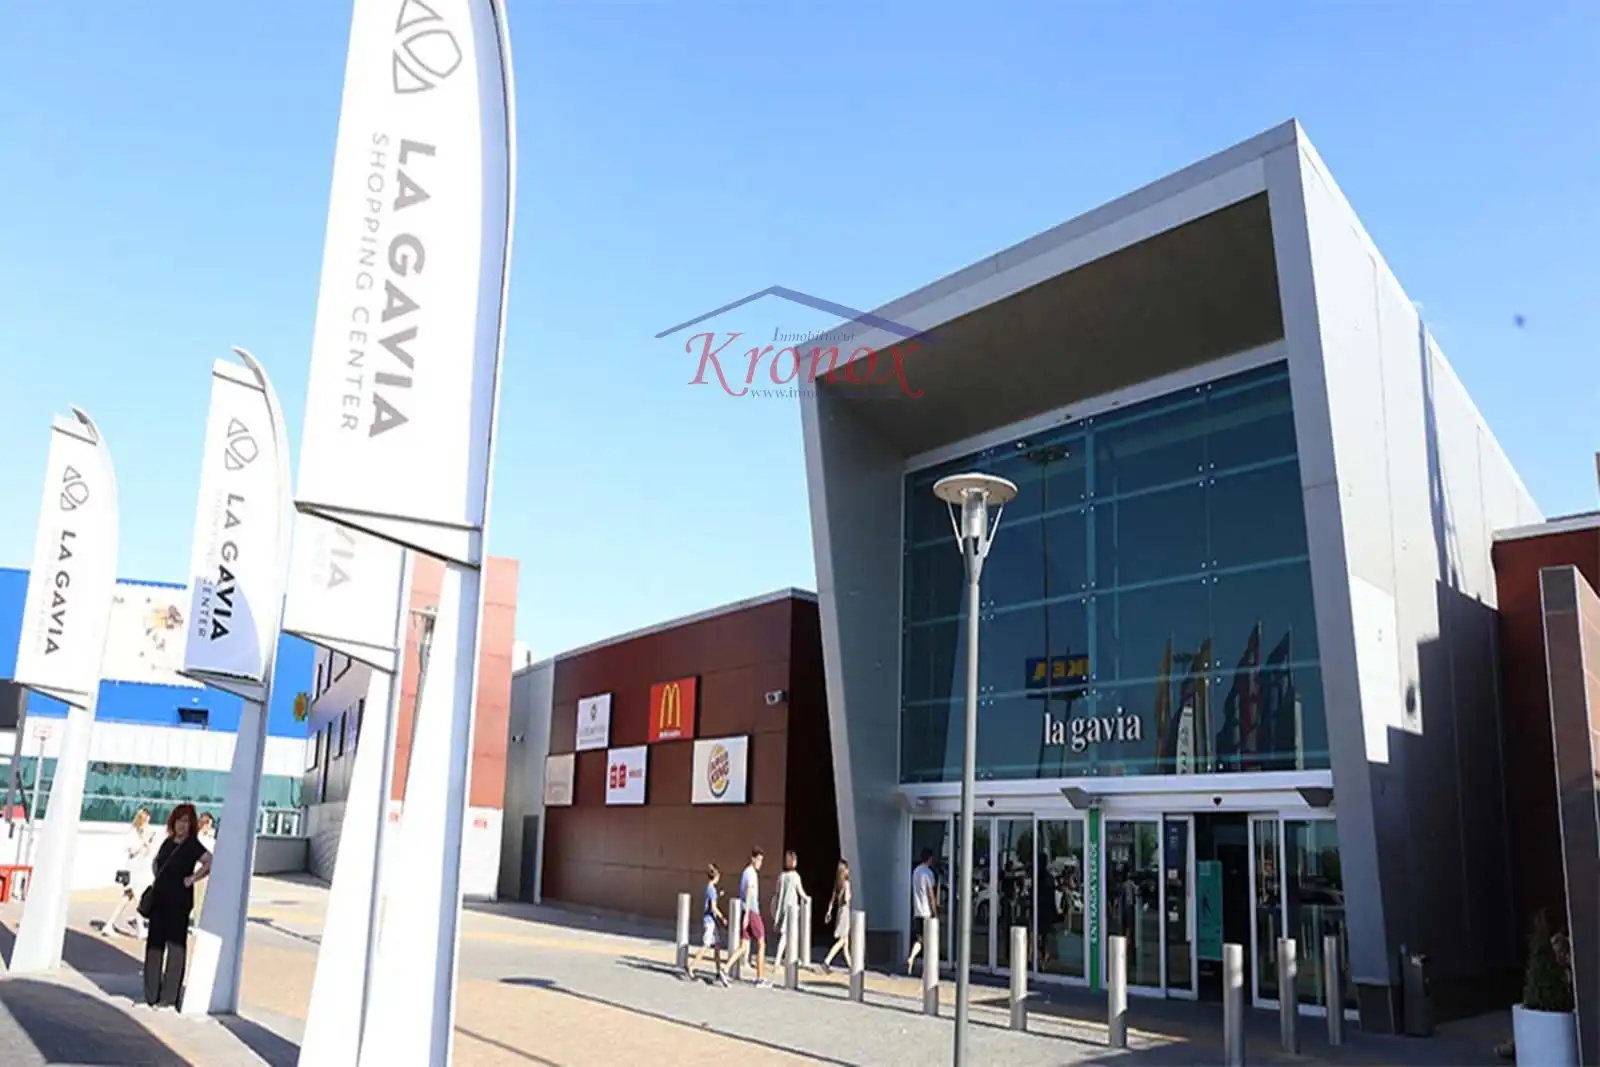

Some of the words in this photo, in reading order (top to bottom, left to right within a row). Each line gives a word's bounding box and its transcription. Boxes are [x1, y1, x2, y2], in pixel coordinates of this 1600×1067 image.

[356, 132, 390, 290] SHOPPING
[393, 139, 436, 211] LA
[340, 306, 370, 431] CENTER
[368, 232, 426, 438] GAVIA
[57, 528, 78, 562] LA
[224, 492, 246, 530] LA
[44, 569, 71, 656] GAVIA
[210, 540, 240, 642] GAVIA
[1044, 712, 1065, 745] la
[1071, 705, 1142, 753] gavia
